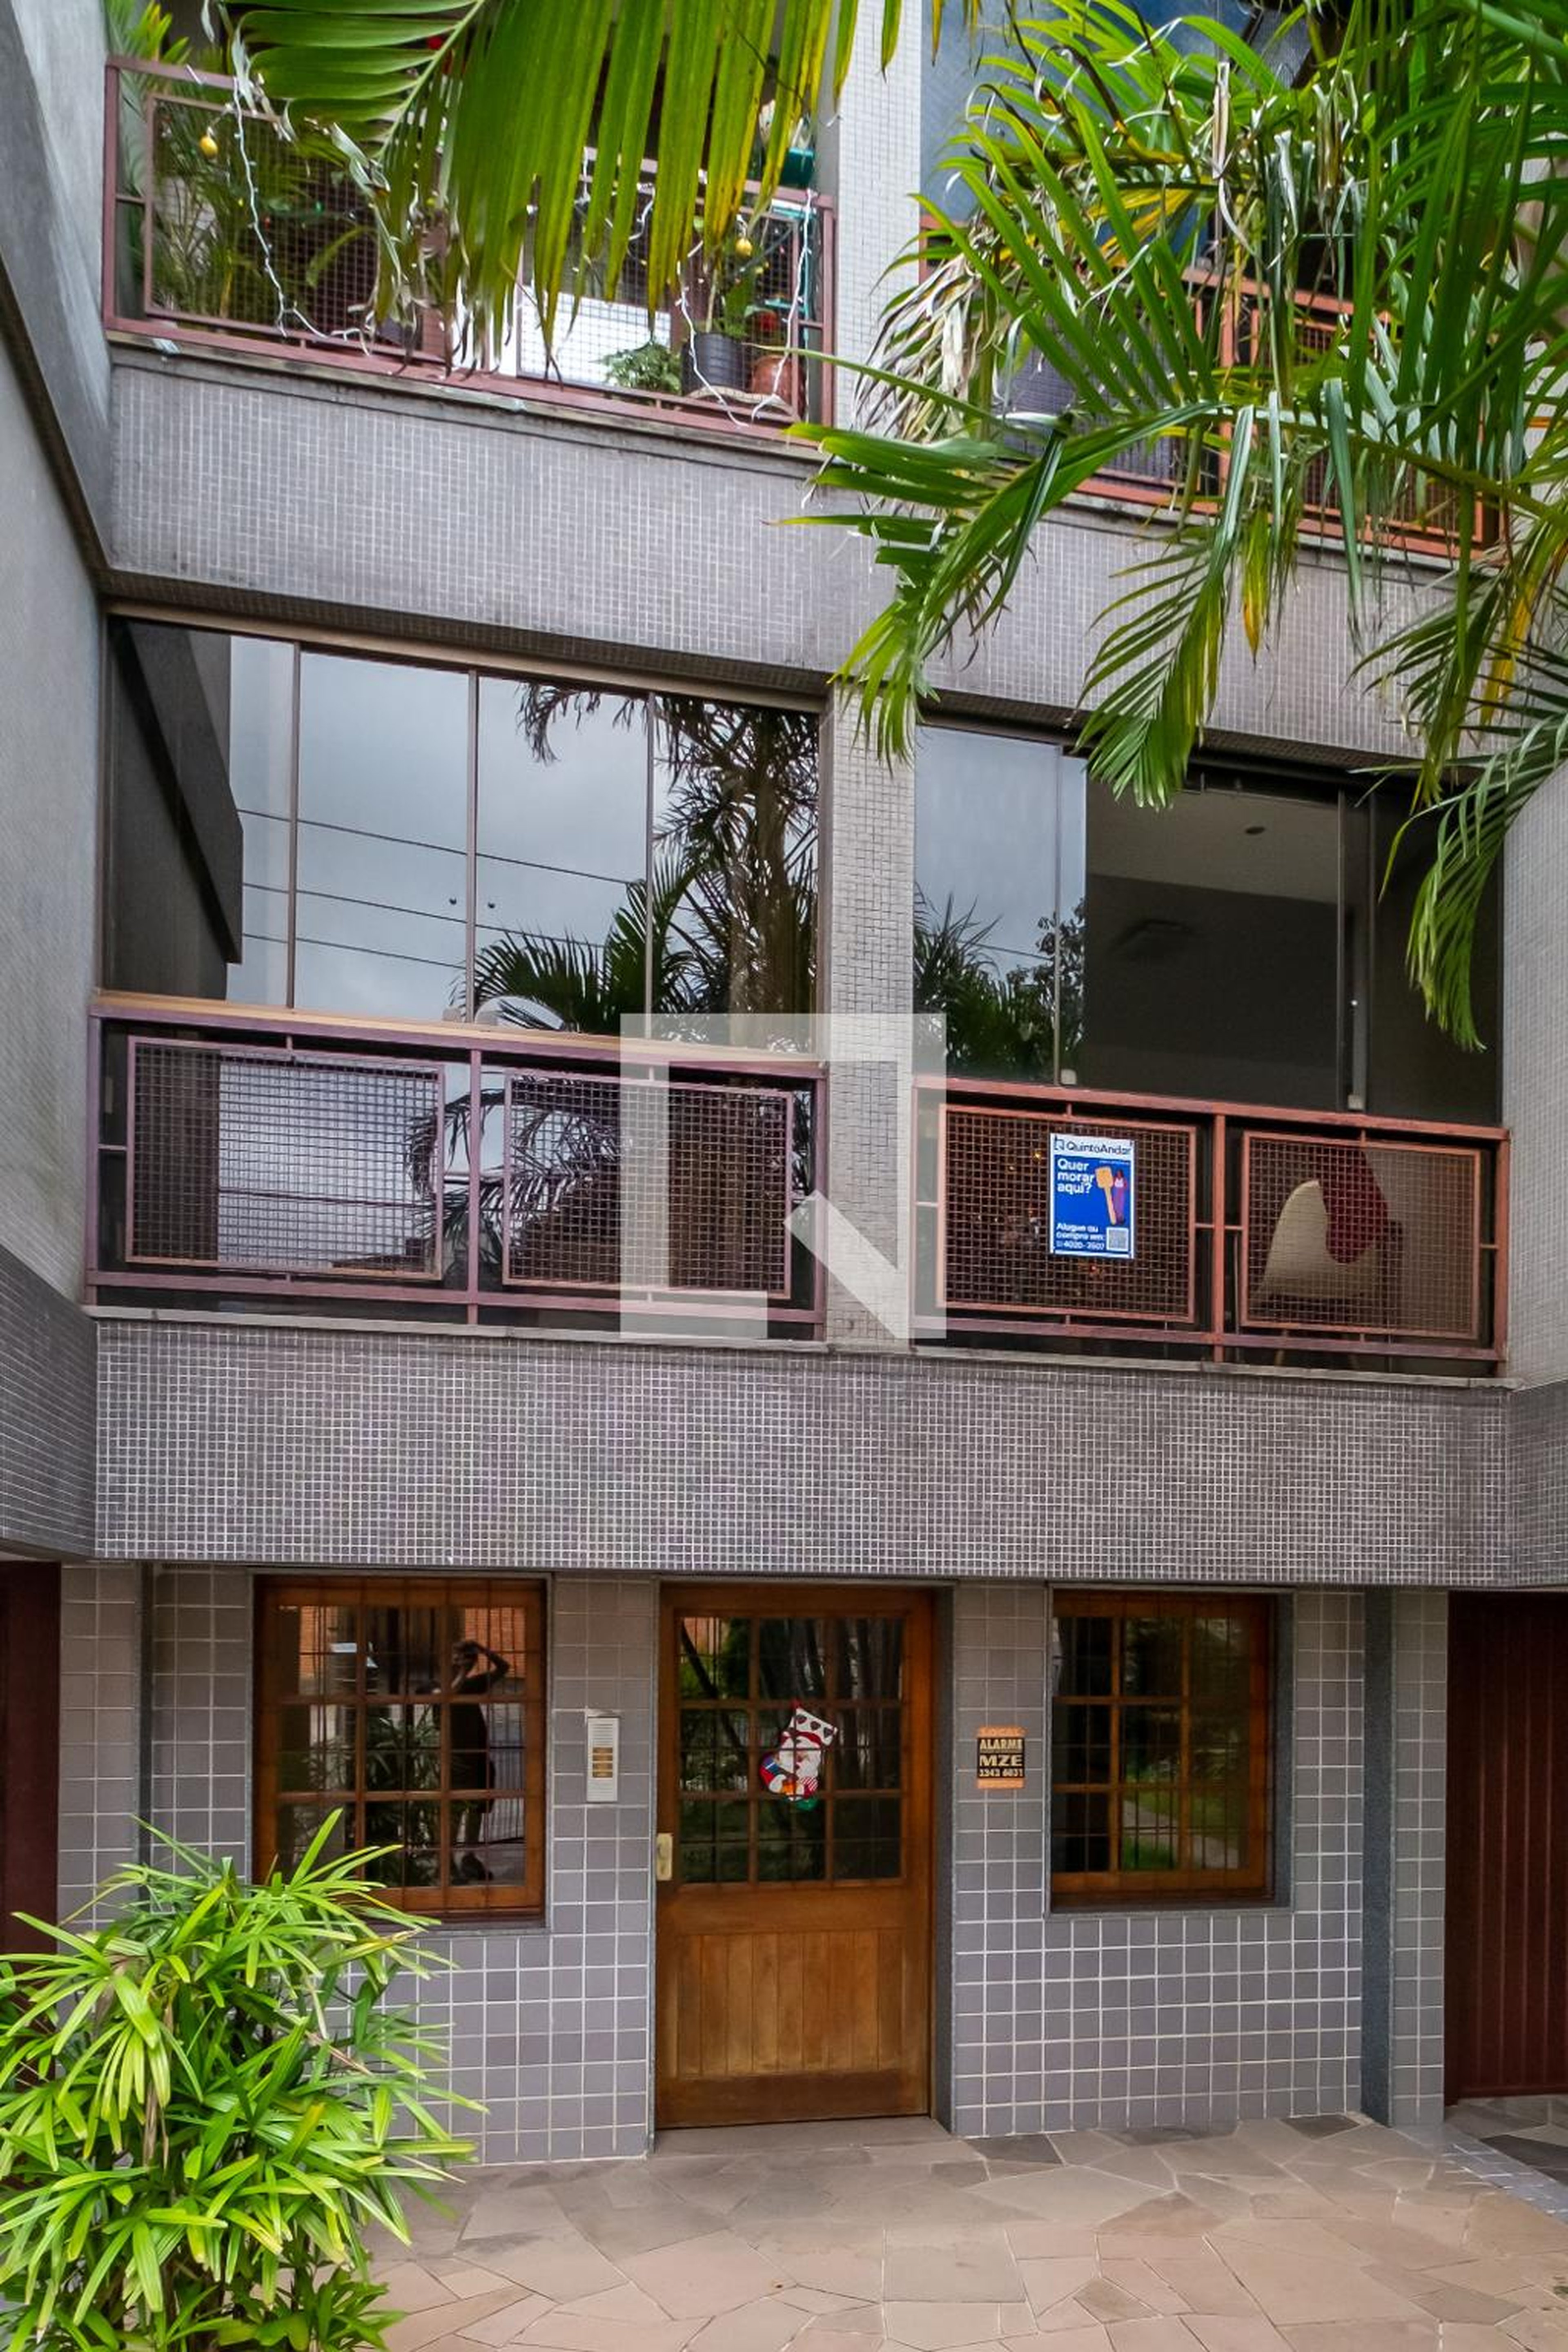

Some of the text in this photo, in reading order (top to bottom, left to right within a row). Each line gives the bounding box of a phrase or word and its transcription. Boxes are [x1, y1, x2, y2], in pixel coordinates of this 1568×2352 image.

[1067, 1141, 1131, 1155] QuintoAndar
[1058, 1158, 1089, 1171] Quer
[1058, 1172, 1095, 1183] morar
[1058, 1183, 1092, 1195] aqui?
[980, 1755, 1022, 1766] MZE
